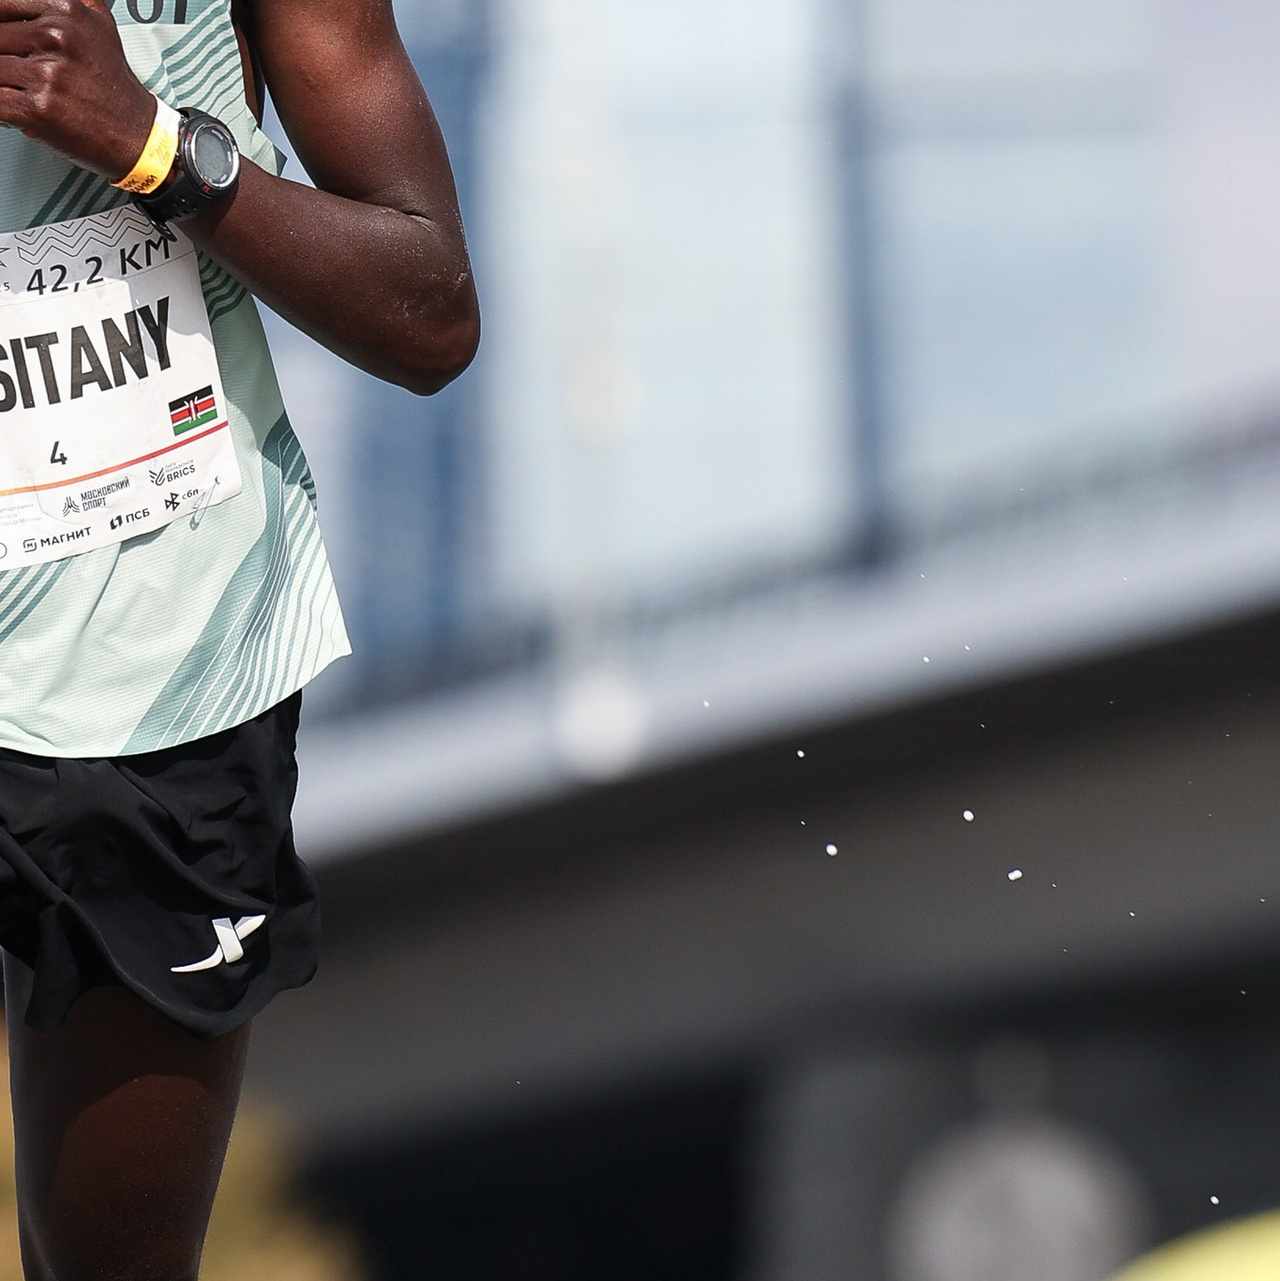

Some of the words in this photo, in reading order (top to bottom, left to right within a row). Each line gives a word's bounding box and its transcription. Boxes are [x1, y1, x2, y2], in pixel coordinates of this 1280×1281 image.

[26, 256, 104, 295] 42,2
[50, 441, 68, 466] 4
[166, 464, 196, 483] BRICS
[80, 476, 131, 502] МОСКОВСКИЙ
[82, 497, 107, 512] СПОРТ
[125, 508, 151, 524] ПСБ
[40, 526, 92, 548] МАГНИТ
